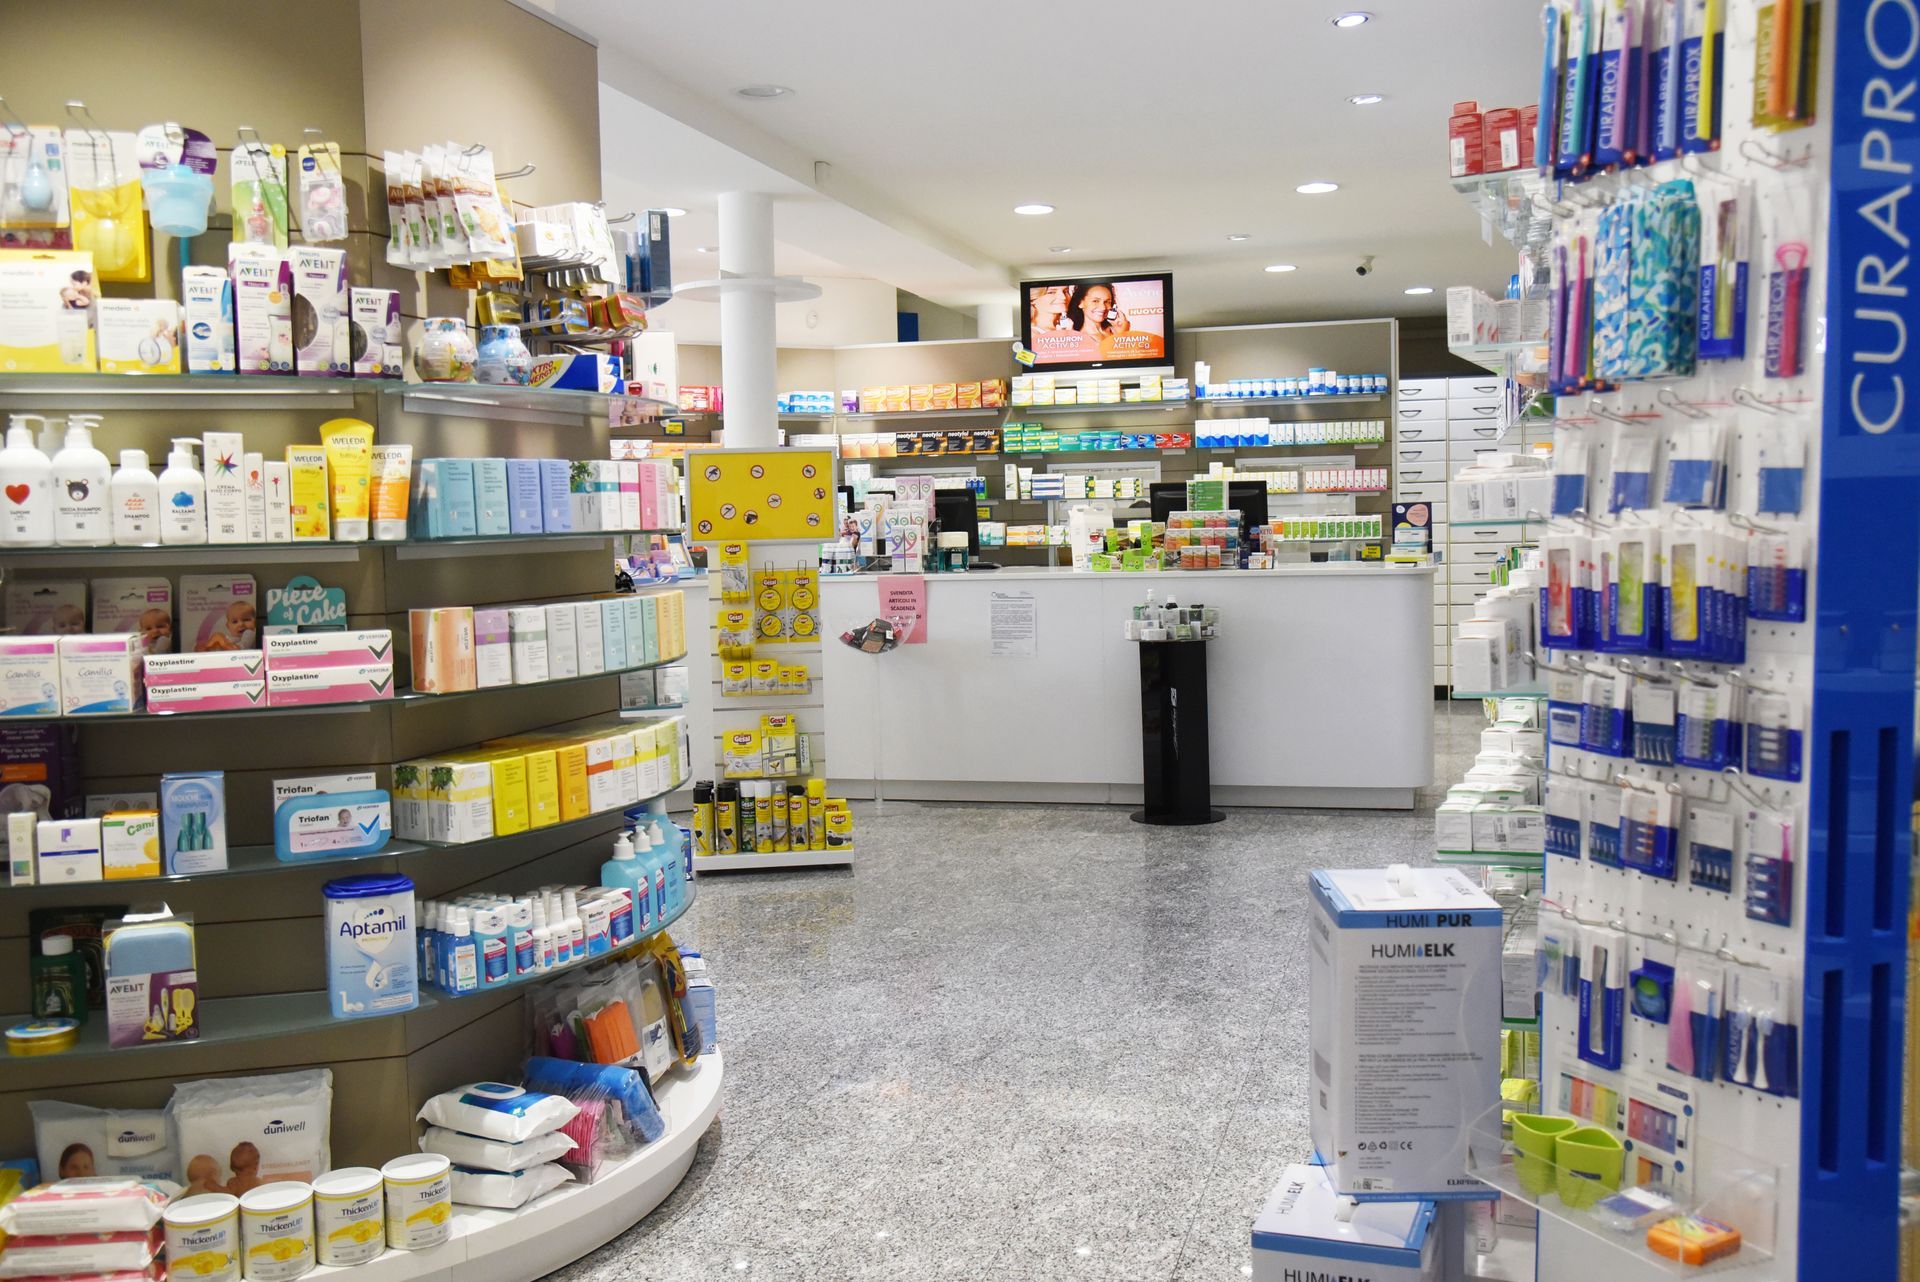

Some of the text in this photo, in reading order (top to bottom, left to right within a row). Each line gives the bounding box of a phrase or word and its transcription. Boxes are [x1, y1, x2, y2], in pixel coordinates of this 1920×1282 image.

[1684, 48, 1701, 140] CURAPROX
[1599, 59, 1618, 149] CURAPROX
[1701, 269, 1712, 340] CURAPROX
[1130, 307, 1164, 317] NUOVO
[1767, 276, 1784, 373] CURAPROX
[1038, 335, 1083, 344] HYALURON
[1114, 335, 1149, 343] VITAMIN
[1043, 342, 1068, 350] ACTIV
[1114, 342, 1136, 350] ACTIV
[372, 452, 402, 460] WELEDA
[266, 585, 328, 613] Piece
[284, 607, 294, 621] of
[297, 599, 346, 626] Cake
[270, 638, 318, 648] Oxyplastine
[148, 658, 195, 668] Oxyplastine
[271, 673, 319, 683] Oxyplastine
[150, 685, 198, 696] Oxyplastine
[769, 716, 787, 725] Gesal
[734, 735, 752, 744] Gesal
[276, 784, 314, 795] Triofan
[299, 815, 331, 824] Triofan
[832, 816, 845, 824] Gesal
[127, 821, 156, 836] Cami
[1386, 913, 1473, 928] HUMI PUR
[340, 915, 406, 940] Aptamil
[1371, 943, 1456, 958] HUMI ELK
[110, 983, 144, 994] AVENT
[264, 1120, 306, 1135] duniwell
[118, 1133, 156, 1144] duniwell
